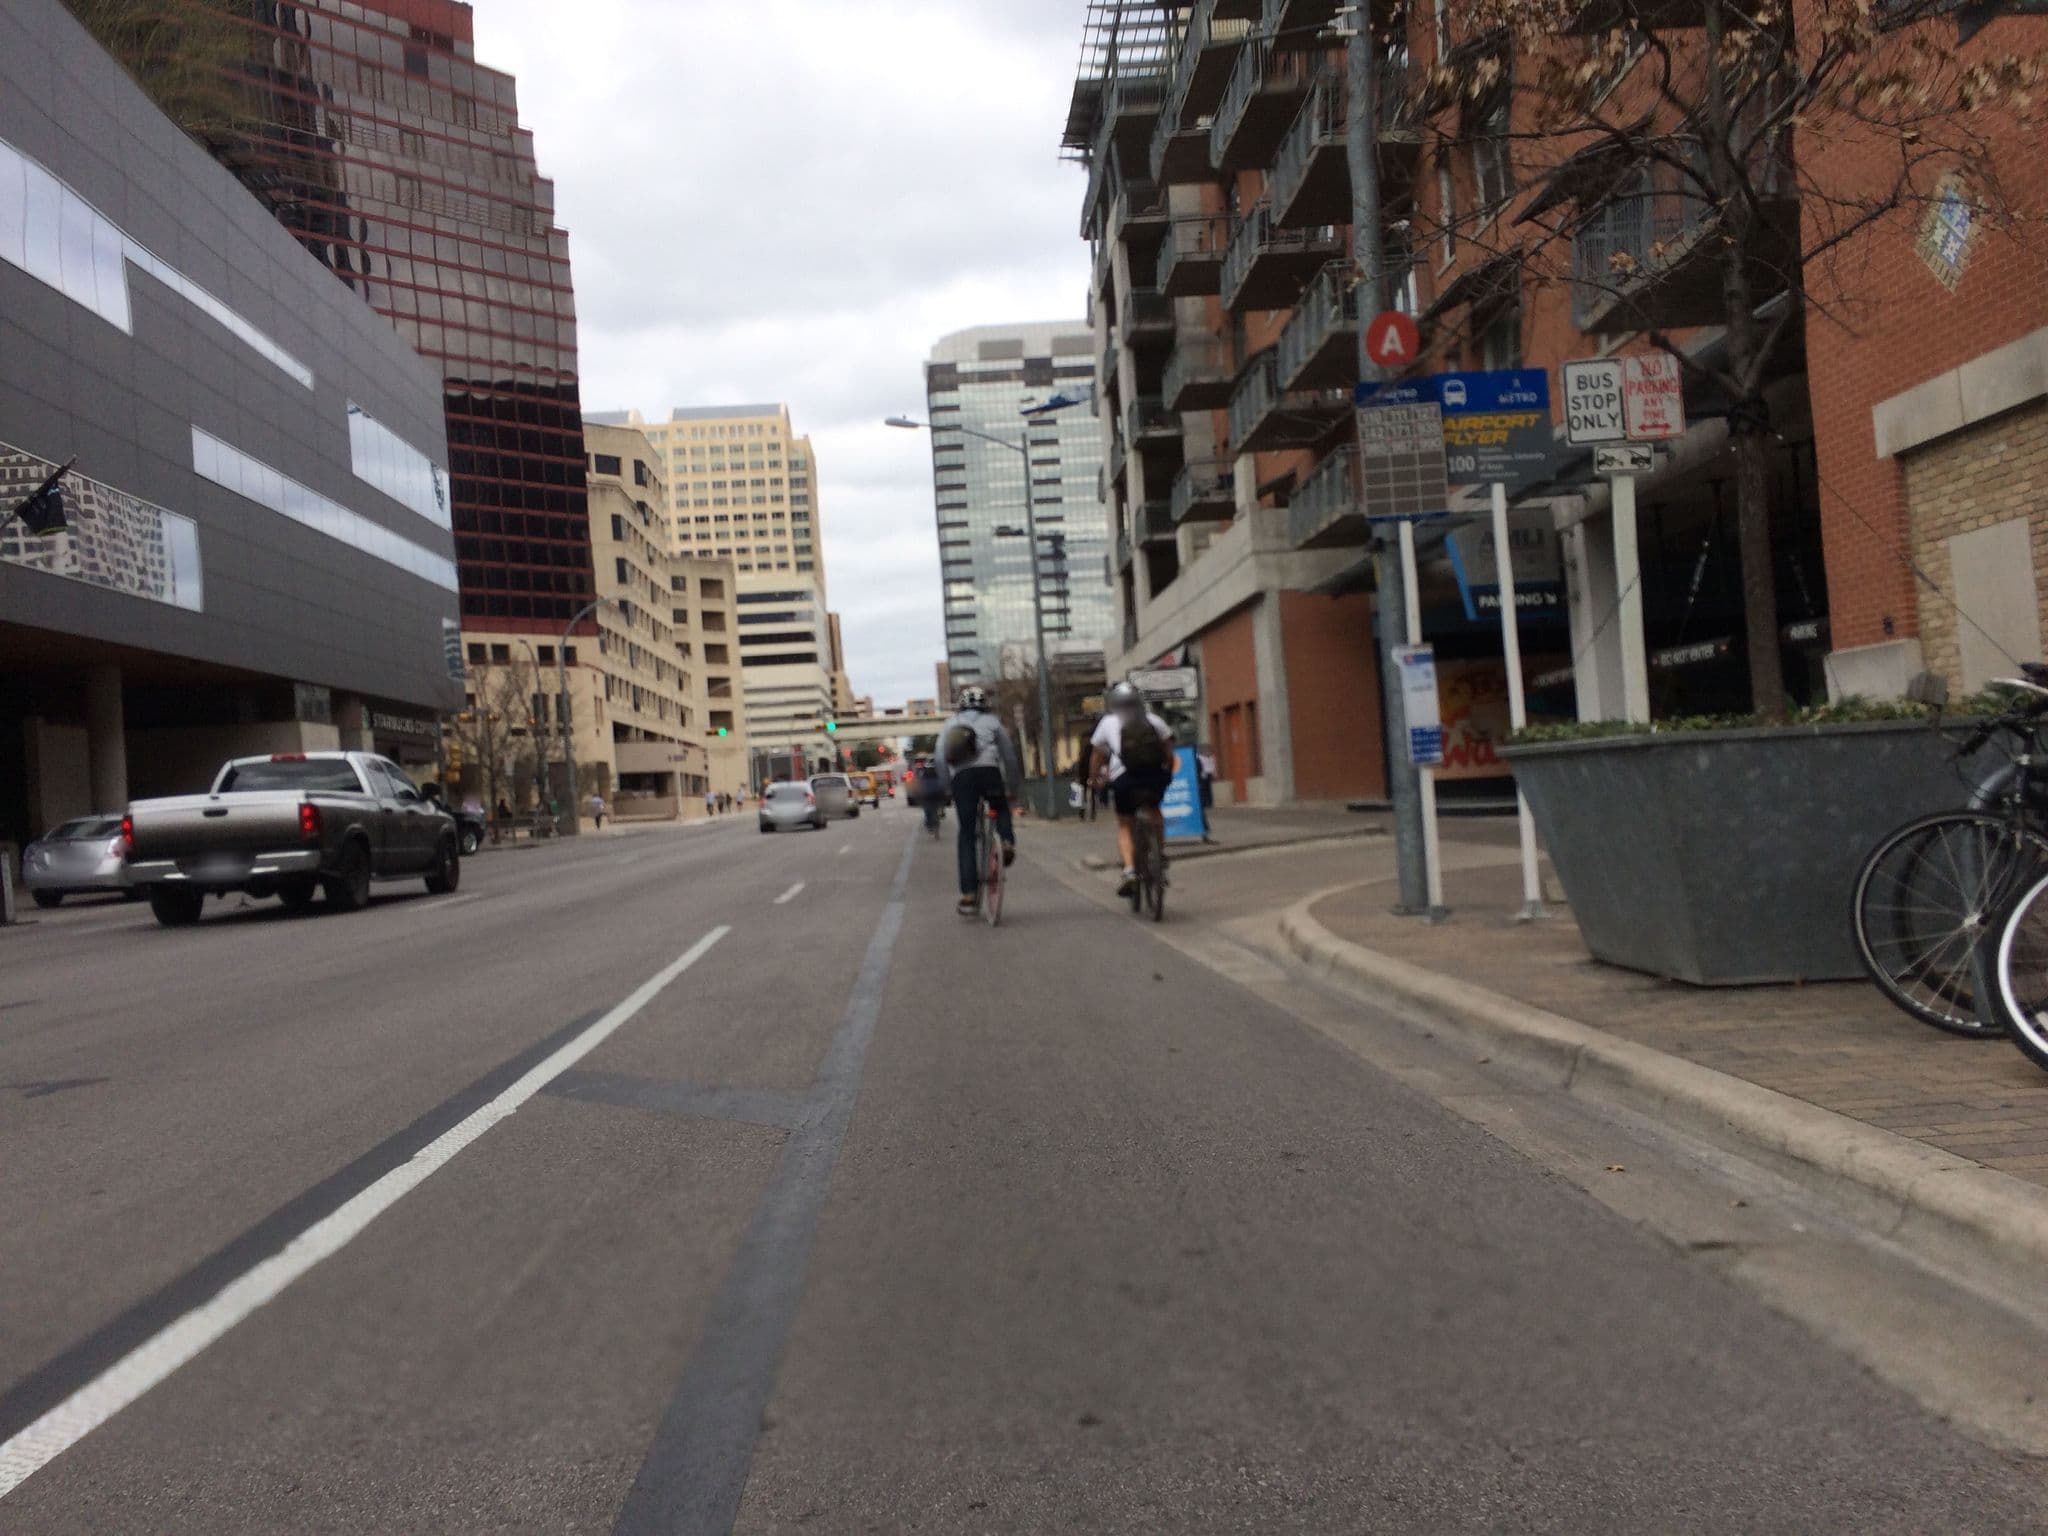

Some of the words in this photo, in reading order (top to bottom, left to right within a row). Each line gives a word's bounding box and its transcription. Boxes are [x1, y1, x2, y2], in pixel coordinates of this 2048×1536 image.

[1380, 325, 1405, 356] A
[1576, 373, 1614, 390] BUS
[1570, 393, 1617, 411] STOP
[1643, 398, 1664, 407] ANY
[1443, 413, 1541, 430] AIRPORT
[1570, 413, 1619, 431] ONLY
[1443, 430, 1508, 446] FLYER
[1448, 455, 1476, 473] 100
